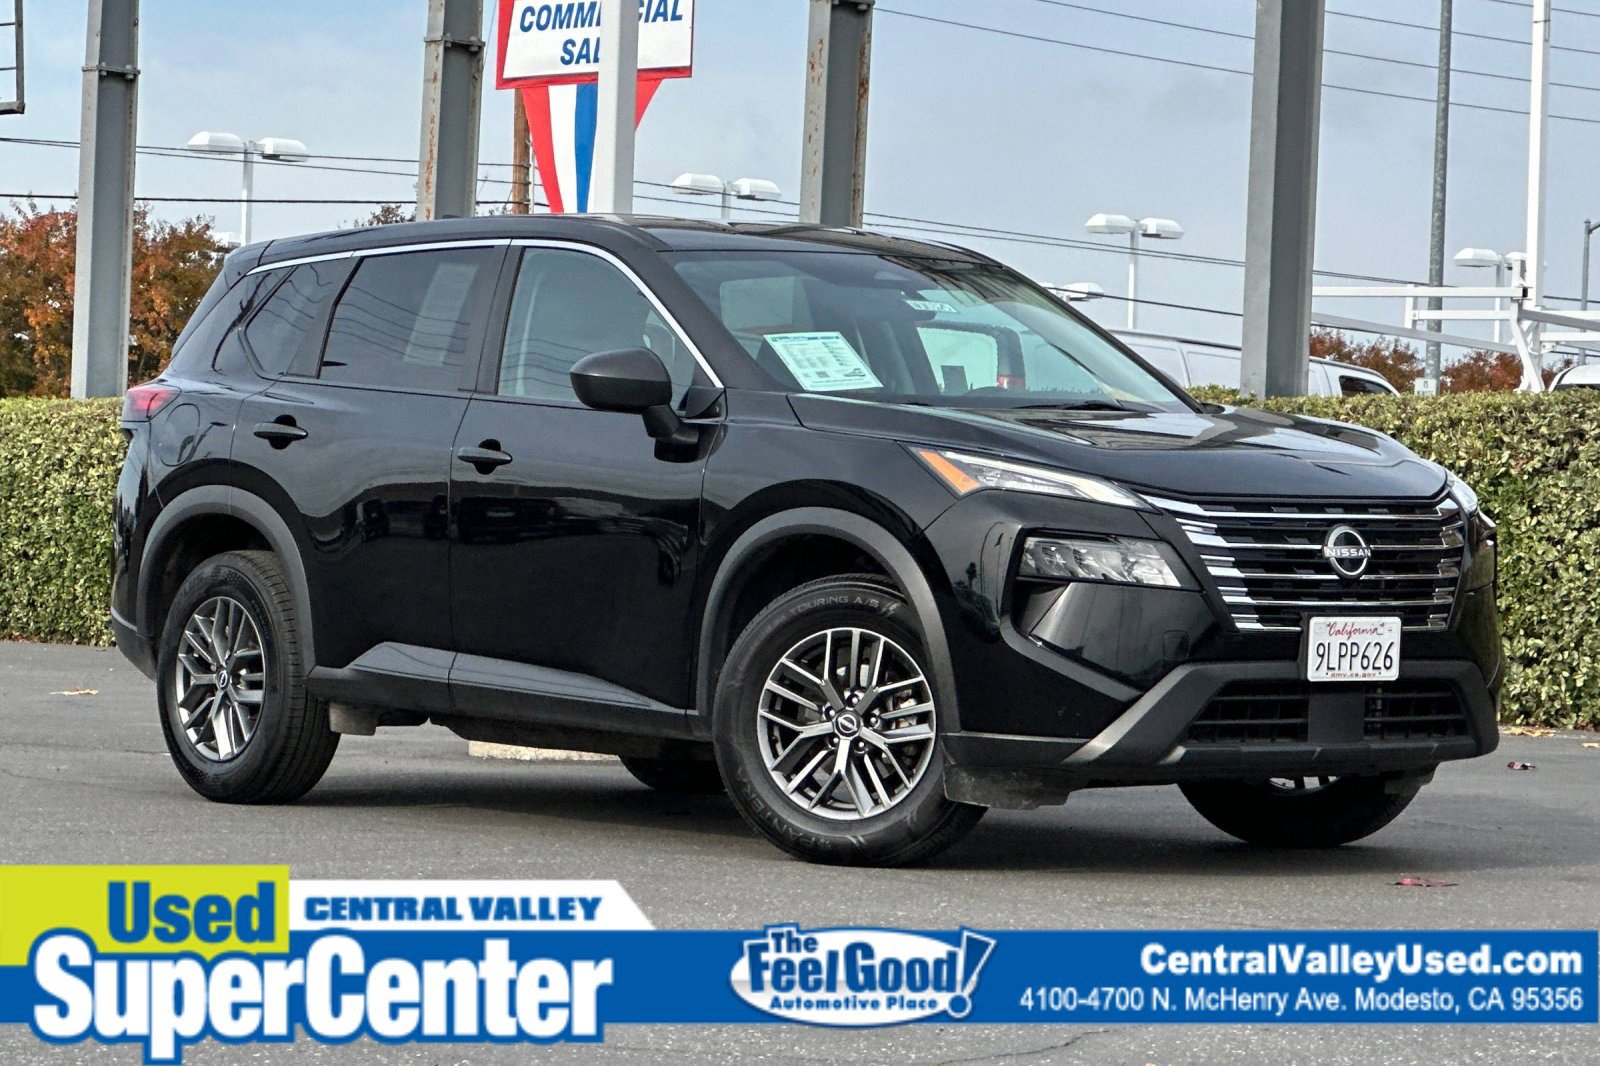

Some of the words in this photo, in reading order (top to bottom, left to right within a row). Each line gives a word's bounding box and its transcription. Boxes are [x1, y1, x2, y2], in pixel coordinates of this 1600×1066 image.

[519, 0, 683, 32] COMMIAL
[560, 37, 600, 65] SAL
[1325, 547, 1372, 558] NISSAN
[1328, 622, 1384, 640] California
[1315, 642, 1394, 671] 9LPP626
